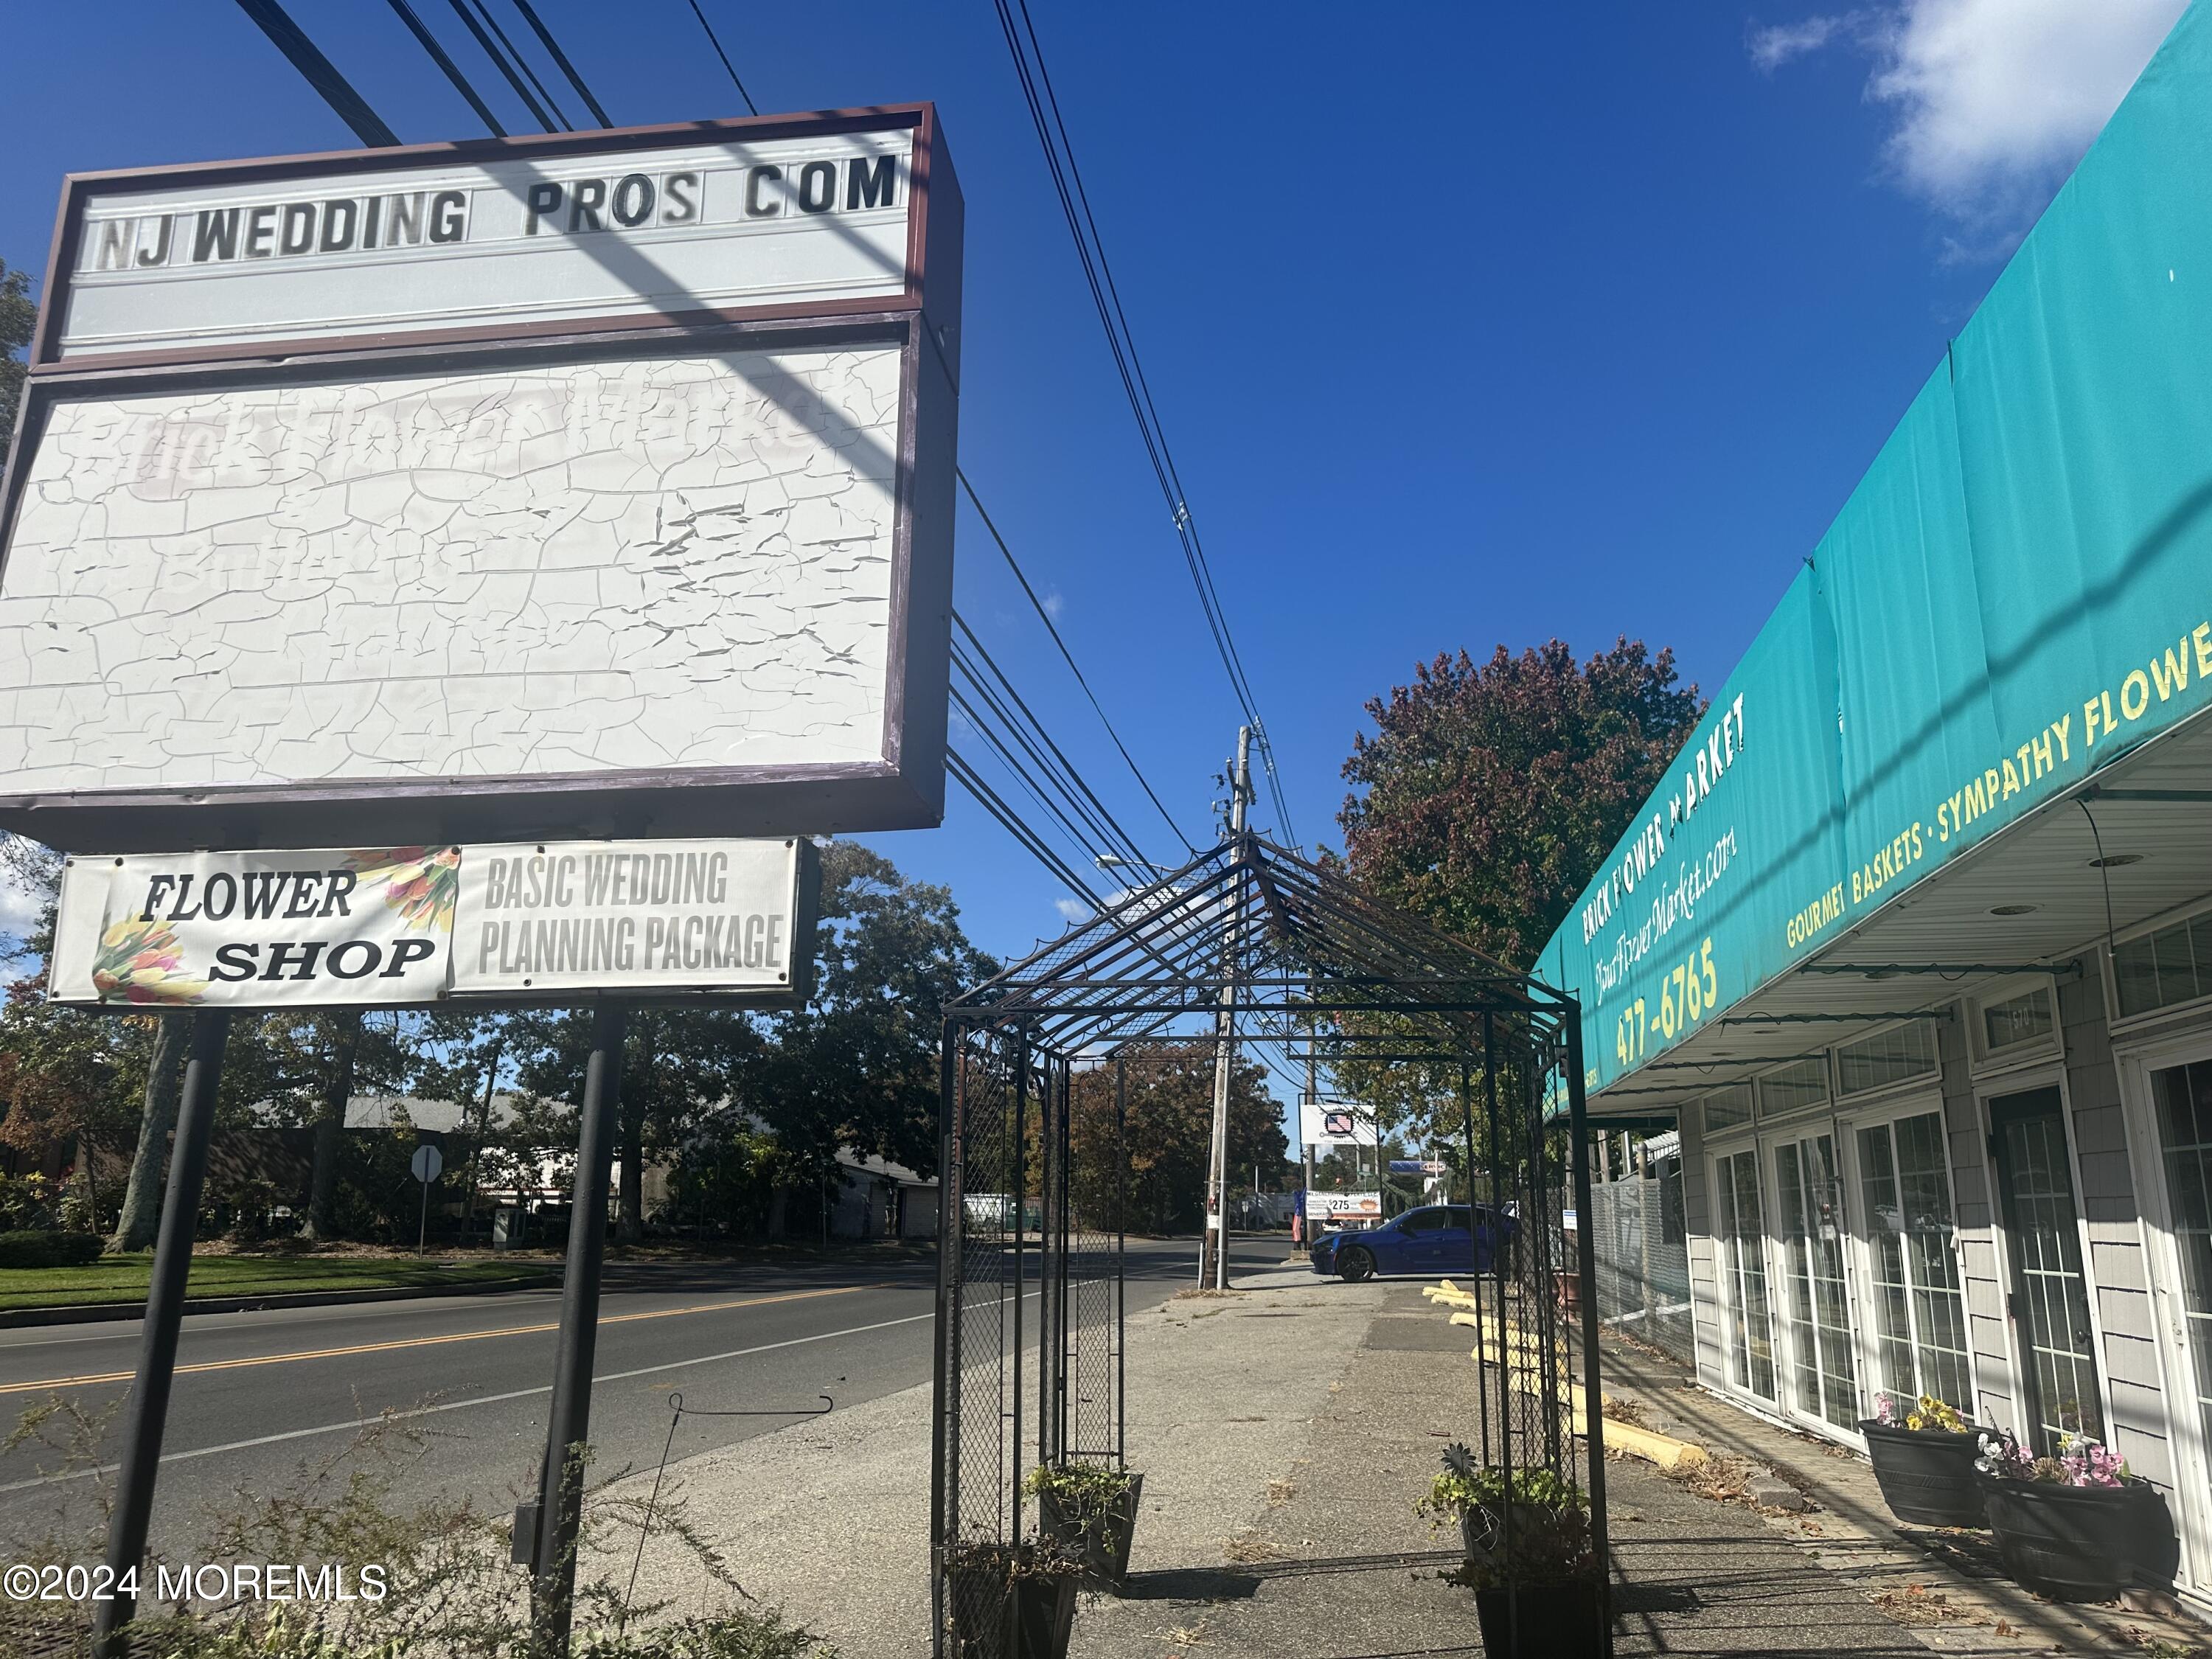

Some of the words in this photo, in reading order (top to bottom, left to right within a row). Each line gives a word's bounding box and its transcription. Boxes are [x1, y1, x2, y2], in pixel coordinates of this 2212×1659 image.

[97, 214, 173, 270] NJ
[192, 191, 467, 262] WEDDING
[525, 172, 698, 236] PROS
[745, 155, 897, 218] COM
[1787, 882, 1846, 949] GOURMET
[1852, 821, 1923, 905] BASKETS
[1937, 712, 2071, 843] SYMPATHY
[139, 869, 358, 922] FLOWER
[484, 855, 576, 910] BASIC
[585, 851, 728, 907] WEDDING
[1582, 880, 1612, 946] BRICK
[208, 939, 436, 982] SHOP
[478, 917, 635, 975] PLANNING
[644, 914, 785, 971] PACKAGE
[1329, 1199, 1349, 1210] $275
